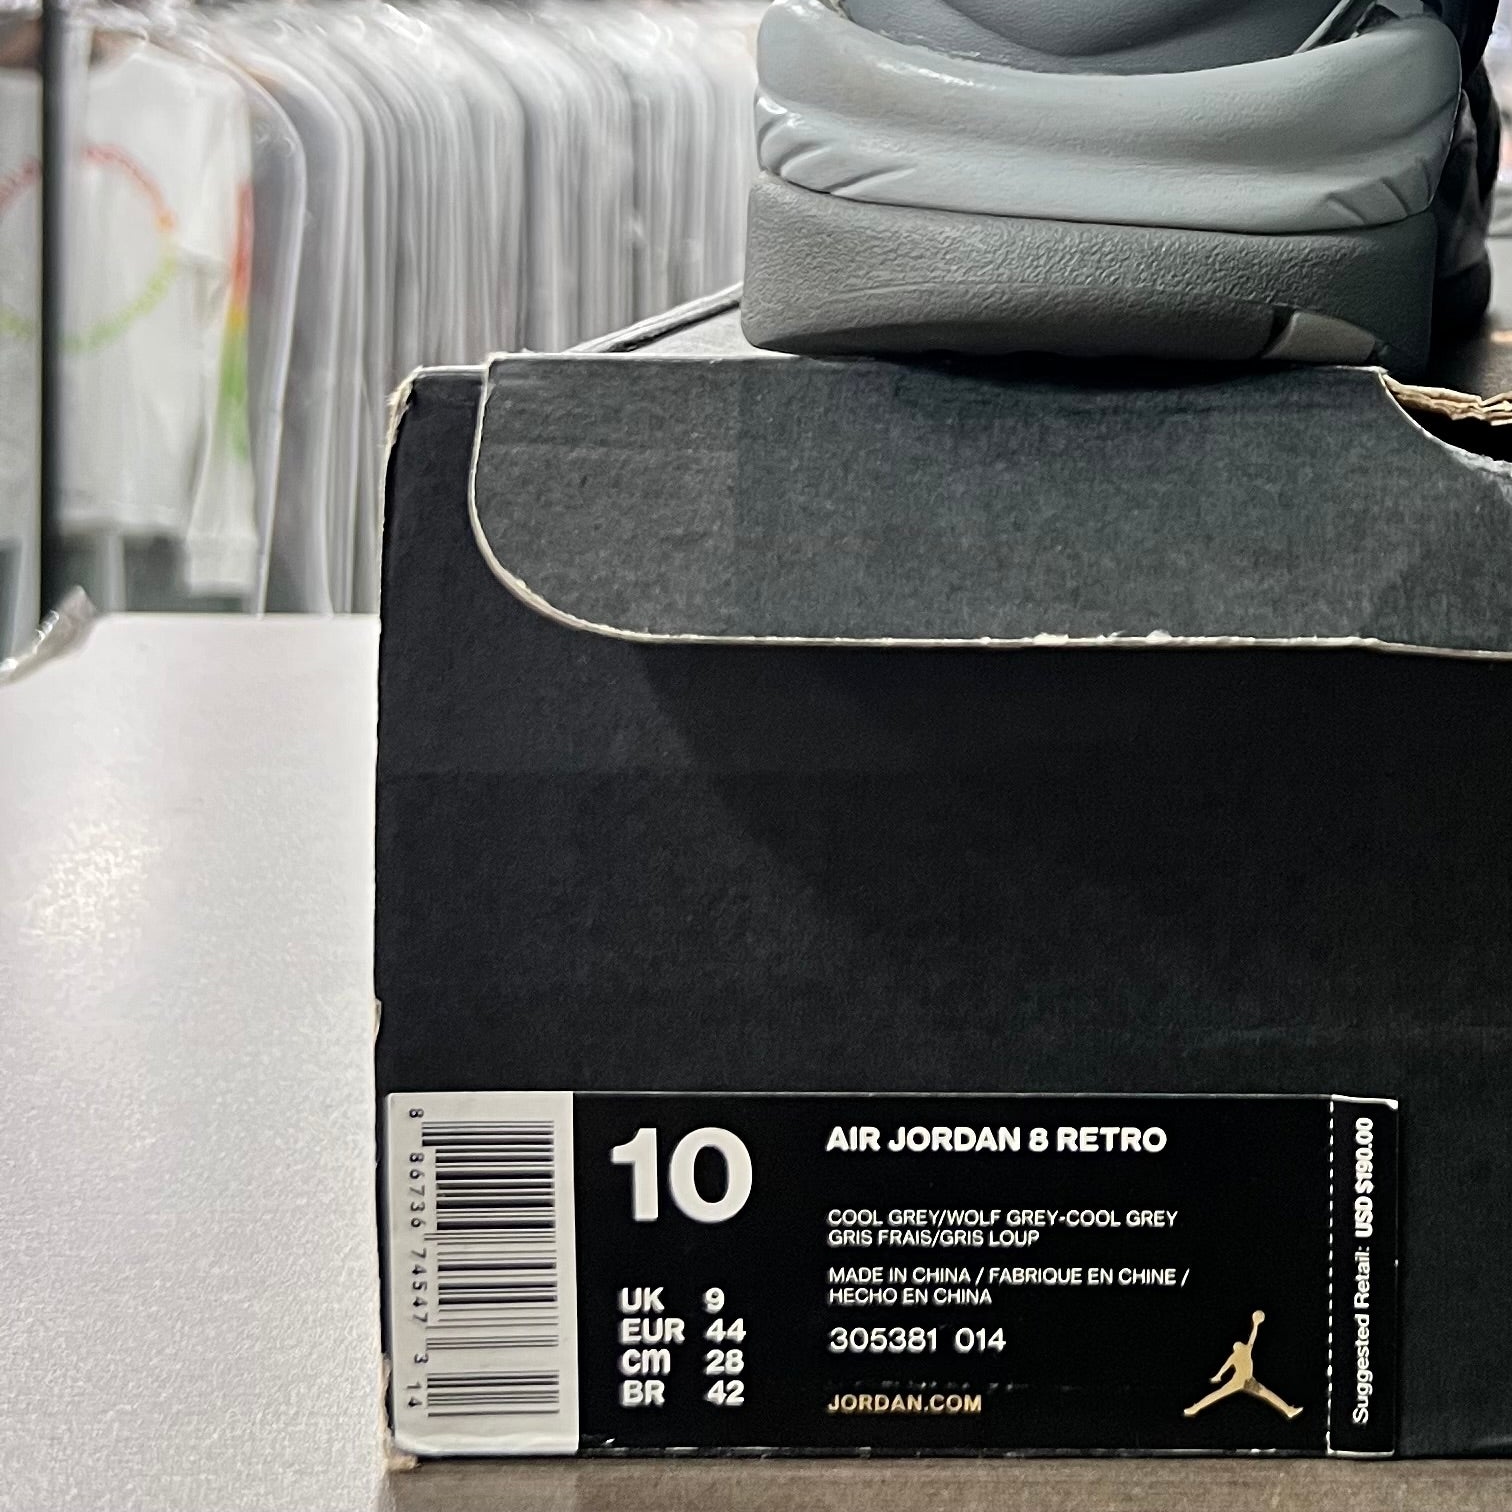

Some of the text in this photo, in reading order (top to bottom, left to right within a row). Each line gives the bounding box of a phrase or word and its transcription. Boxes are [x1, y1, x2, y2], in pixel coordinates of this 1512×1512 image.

[408, 1107, 425, 1119] 8
[824, 1125, 1168, 1154] AIR JORDAN 8 RETRO
[610, 1126, 753, 1223] 10
[408, 1151, 427, 1229] 86736
[827, 1208, 1179, 1228] COOL GREY/WOLF GREY-COOL GREY
[828, 1229, 1040, 1248] GRIS FRAIS/GRIS LOUP
[410, 1247, 429, 1323] 74547
[828, 1266, 1190, 1287] MADE IN CHINA / FABRIQUE EN CHINE /
[1353, 1244, 1372, 1310] Retail:
[619, 1286, 725, 1314] UK 9
[829, 1287, 993, 1306] HECHO EN CHINA
[620, 1317, 747, 1345] EUR 44
[830, 1326, 1007, 1353] 305381 014
[413, 1352, 430, 1365] 3
[620, 1348, 745, 1376] cm 28
[1352, 1312, 1375, 1425] Suggested
[621, 1379, 745, 1407] BR 42
[828, 1393, 982, 1414] JORDAN.COM
